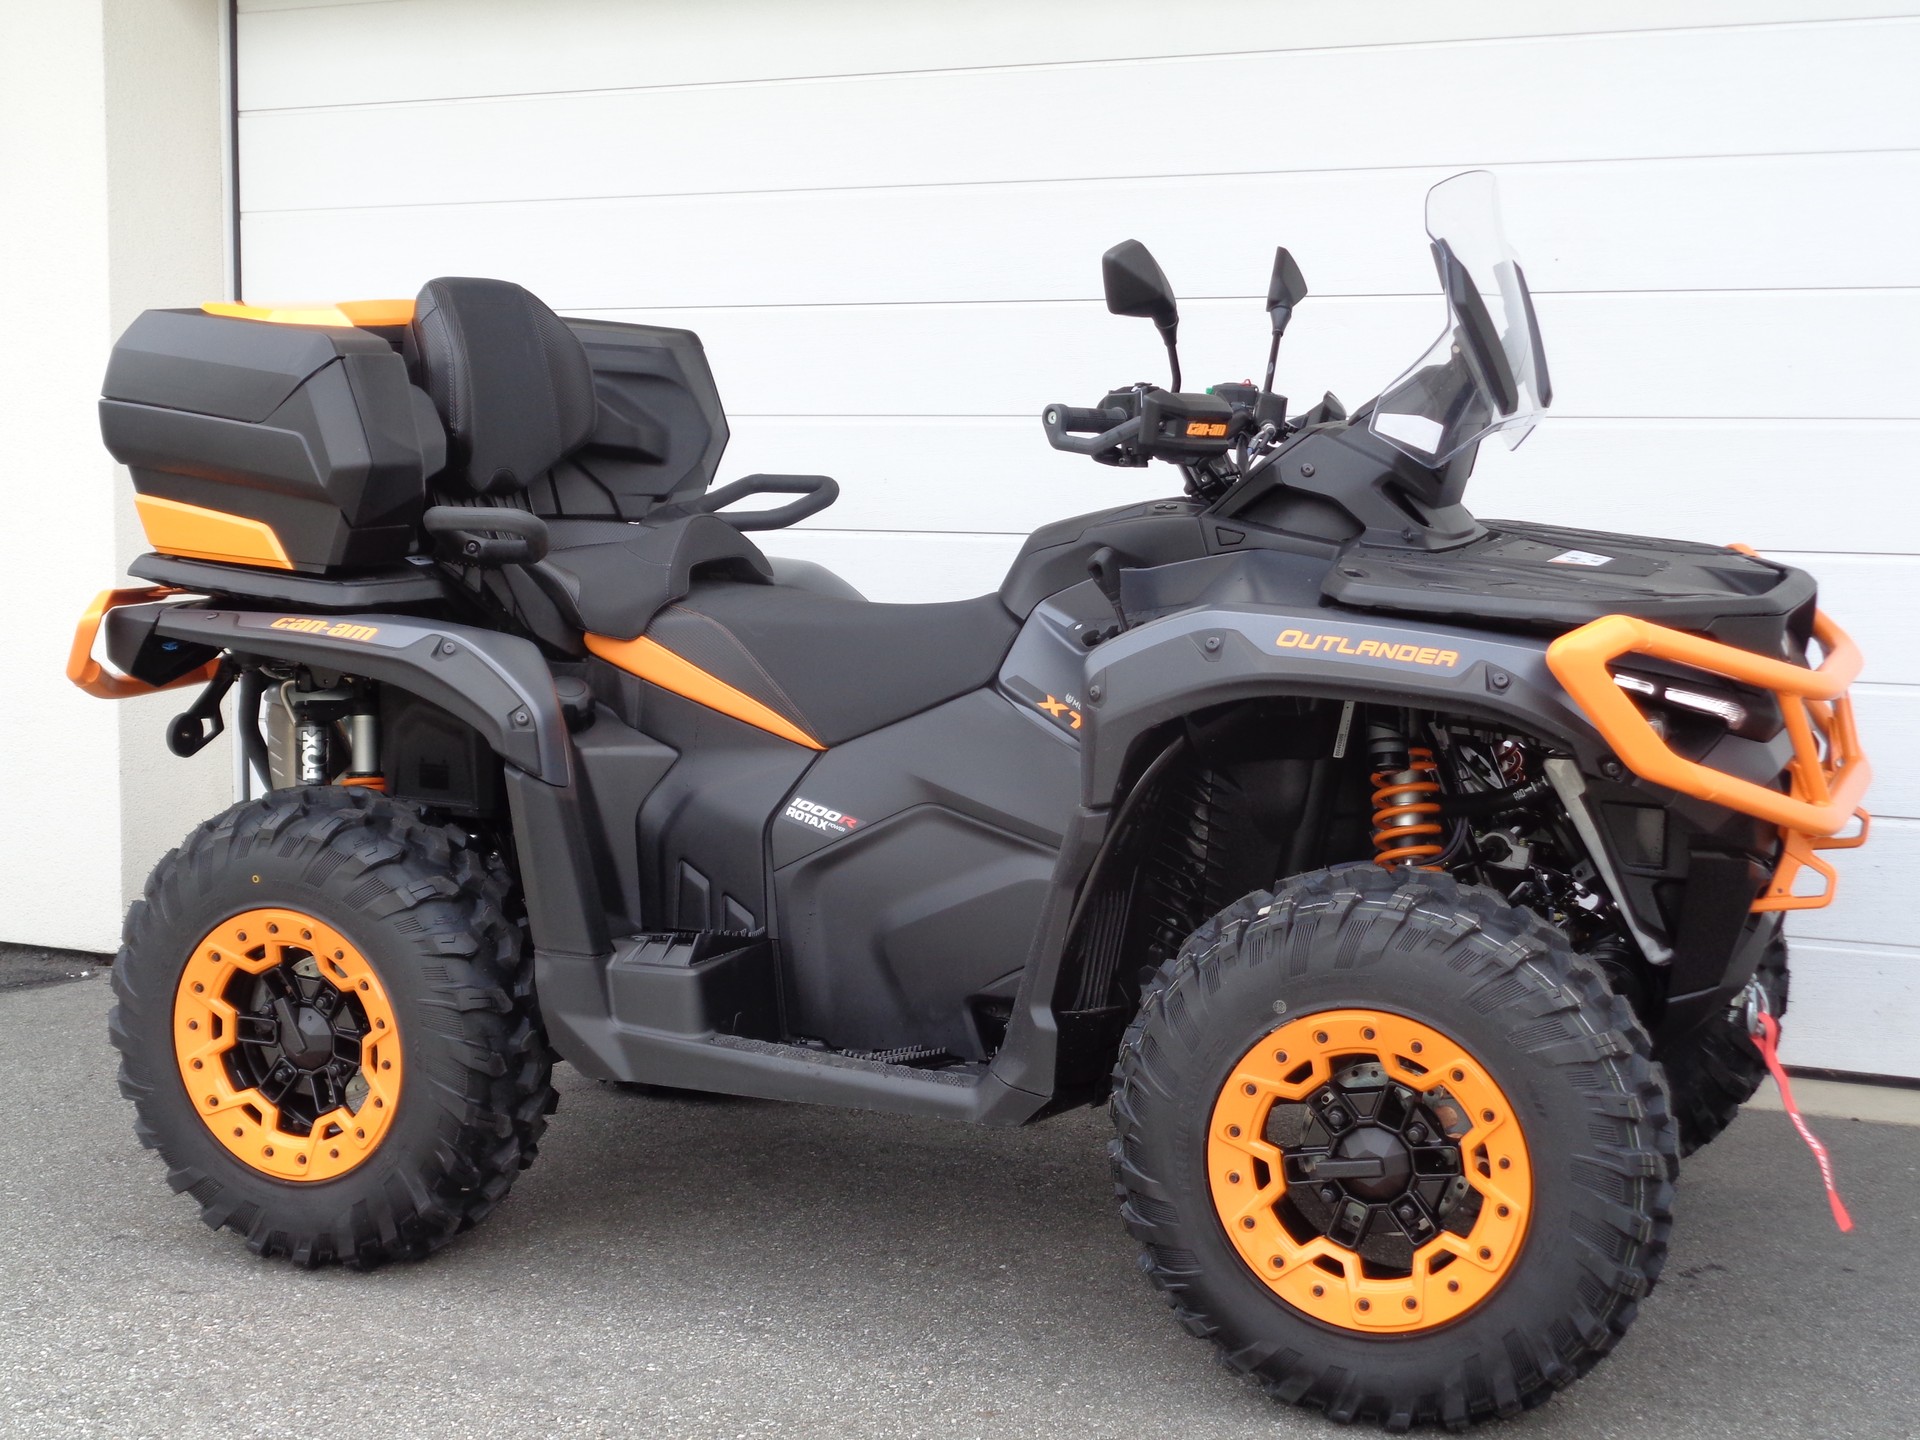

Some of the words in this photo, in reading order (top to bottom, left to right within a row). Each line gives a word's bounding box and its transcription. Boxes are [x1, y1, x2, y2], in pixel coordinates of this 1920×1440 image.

[270, 617, 378, 641] can-am
[1275, 629, 1459, 667] OUTLANDER
[785, 806, 829, 831] ROTAX
[827, 822, 846, 832] POWER
[790, 797, 857, 829] 1000R
